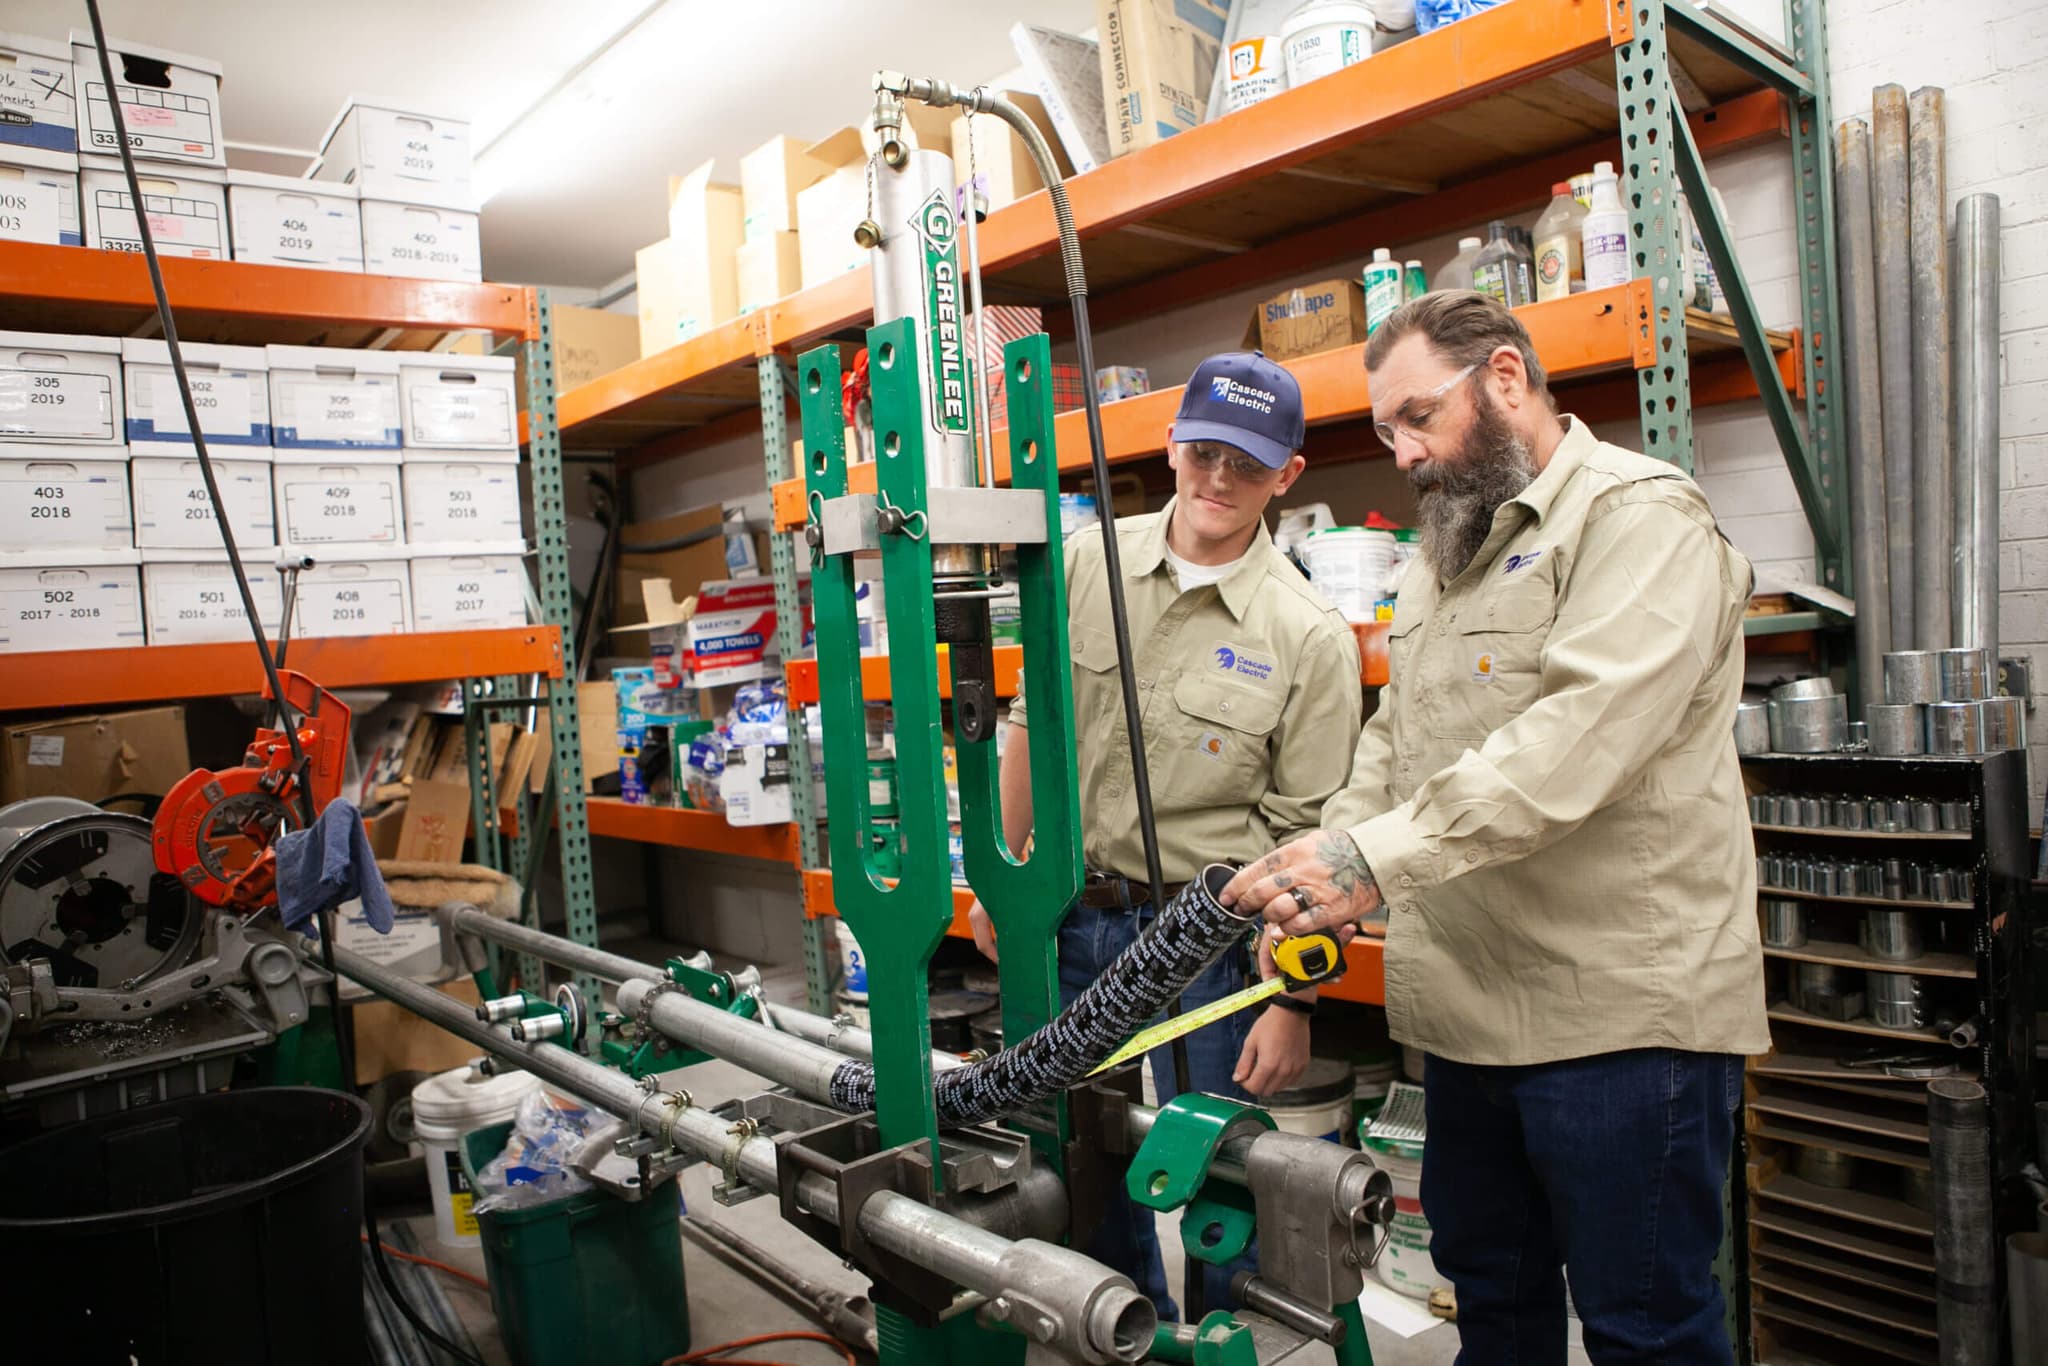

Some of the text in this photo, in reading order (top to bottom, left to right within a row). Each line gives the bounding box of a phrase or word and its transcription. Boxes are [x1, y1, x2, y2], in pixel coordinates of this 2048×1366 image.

[1108, 12, 1126, 90] CONNECTOR
[406, 141, 429, 153] 404
[403, 157, 434, 171] 2019
[282, 219, 308, 232] 406
[279, 236, 313, 250] 2019
[413, 233, 437, 245] 400
[934, 260, 965, 421] GREENLEE
[34, 377, 60, 388] 305
[1229, 381, 1276, 404] Cascade
[31, 393, 65, 405] 2019
[194, 397, 218, 408] 020
[1226, 392, 1271, 414] Electric
[34, 487, 65, 499] 403
[187, 490, 207, 500] 40
[326, 488, 350, 499] 409
[449, 491, 472, 501] 503
[31, 506, 71, 519] 2018
[323, 505, 356, 516] 2018
[447, 507, 477, 518] 2018
[457, 583, 480, 593] 400
[44, 591, 74, 603] 502
[199, 592, 226, 603] 501
[455, 600, 484, 611] 2017
[20, 610, 51, 621] 2017
[70, 607, 101, 619] 2018
[332, 608, 365, 620] 2018
[724, 636, 760, 648] TOWELS
[1236, 655, 1273, 673] Cascade
[1236, 664, 1268, 680] Electric
[1186, 904, 1214, 936] Dottie
[1148, 940, 1175, 969] Dottie
[1138, 974, 1170, 995] Dottie
[1105, 985, 1131, 1014] Dottie
[1130, 983, 1162, 1006] Dottie
